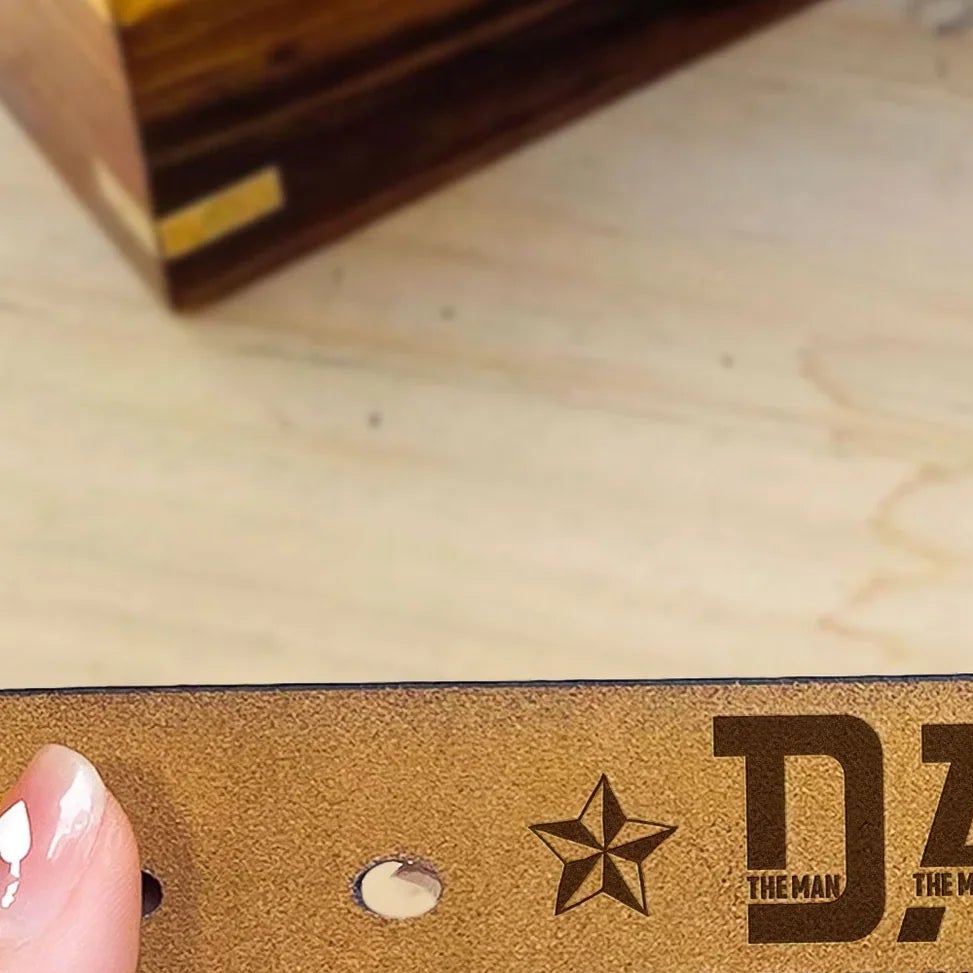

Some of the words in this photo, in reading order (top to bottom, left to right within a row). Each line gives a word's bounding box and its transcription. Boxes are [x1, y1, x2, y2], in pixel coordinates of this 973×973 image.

[747, 874, 789, 900] THE
[791, 873, 841, 900] MAN
[913, 872, 954, 897] THE
